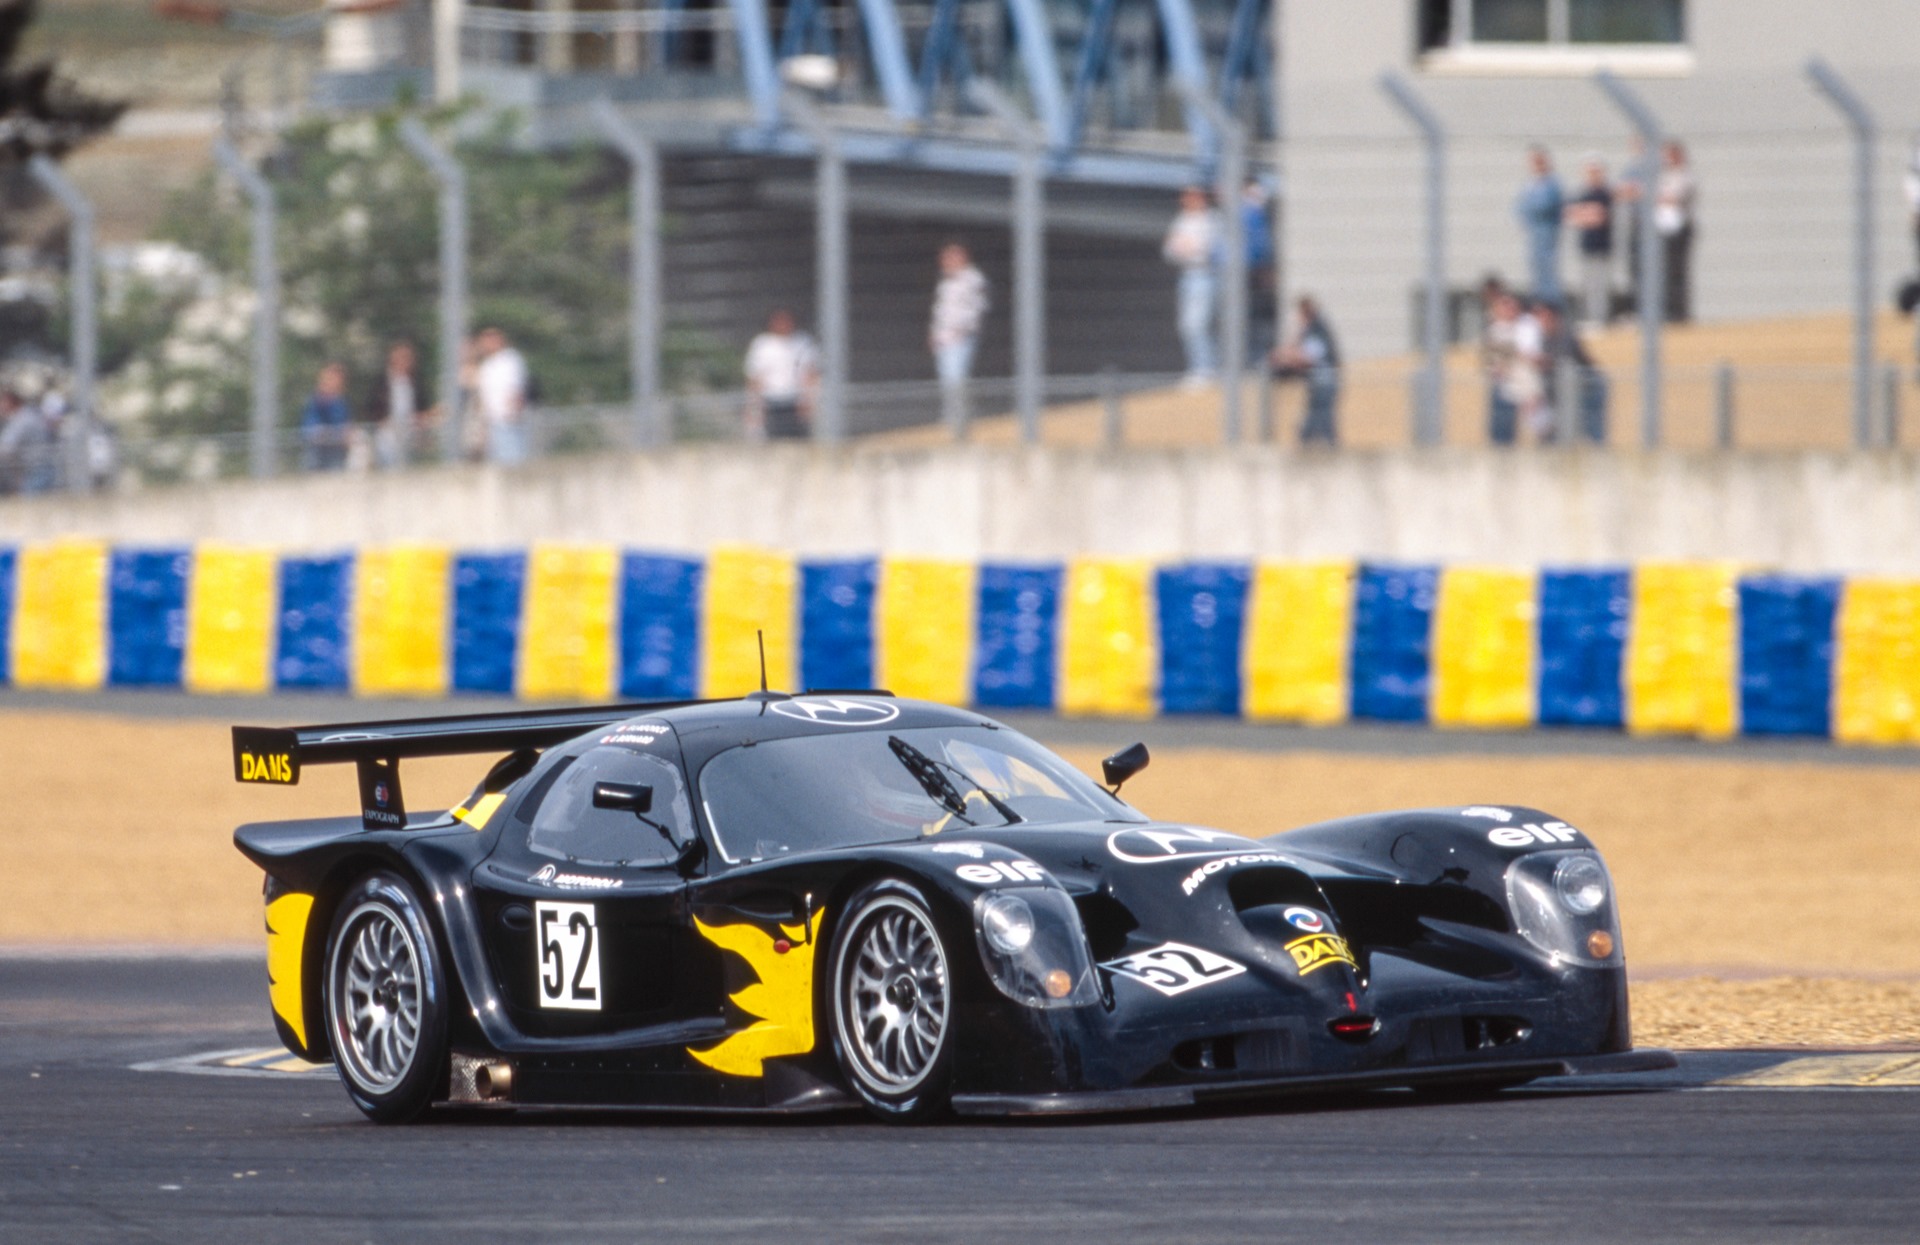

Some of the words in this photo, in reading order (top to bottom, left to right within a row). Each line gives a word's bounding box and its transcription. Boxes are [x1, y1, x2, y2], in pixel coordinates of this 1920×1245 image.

[242, 753, 292, 782] DAMS
[1488, 822, 1577, 846] elf
[956, 861, 1045, 883] elf
[540, 910, 596, 1001] 52
[1106, 950, 1234, 988] 52
